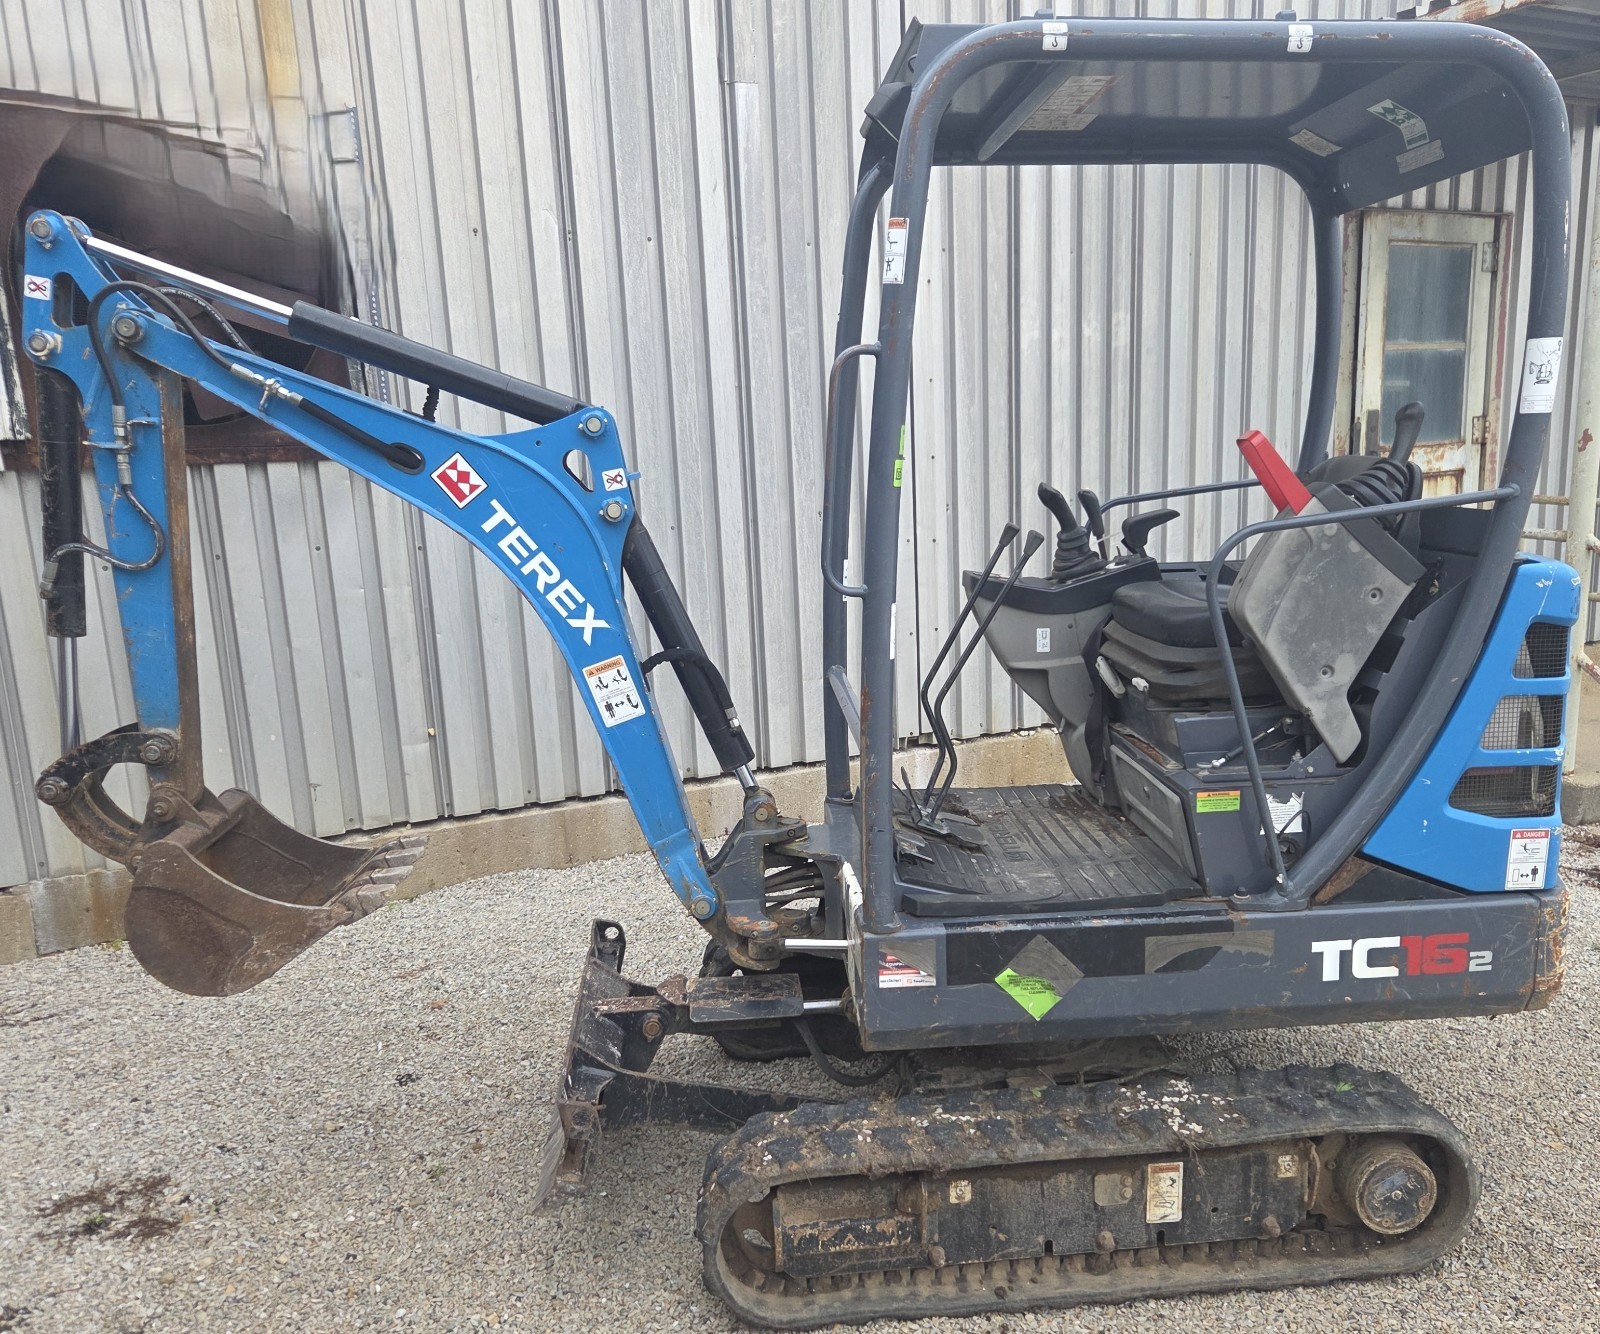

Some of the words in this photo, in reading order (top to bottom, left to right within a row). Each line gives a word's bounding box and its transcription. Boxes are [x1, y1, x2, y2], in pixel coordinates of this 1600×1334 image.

[481, 498, 610, 646] TEREX
[594, 660, 621, 673] WARNING
[1523, 831, 1546, 839] DANGER
